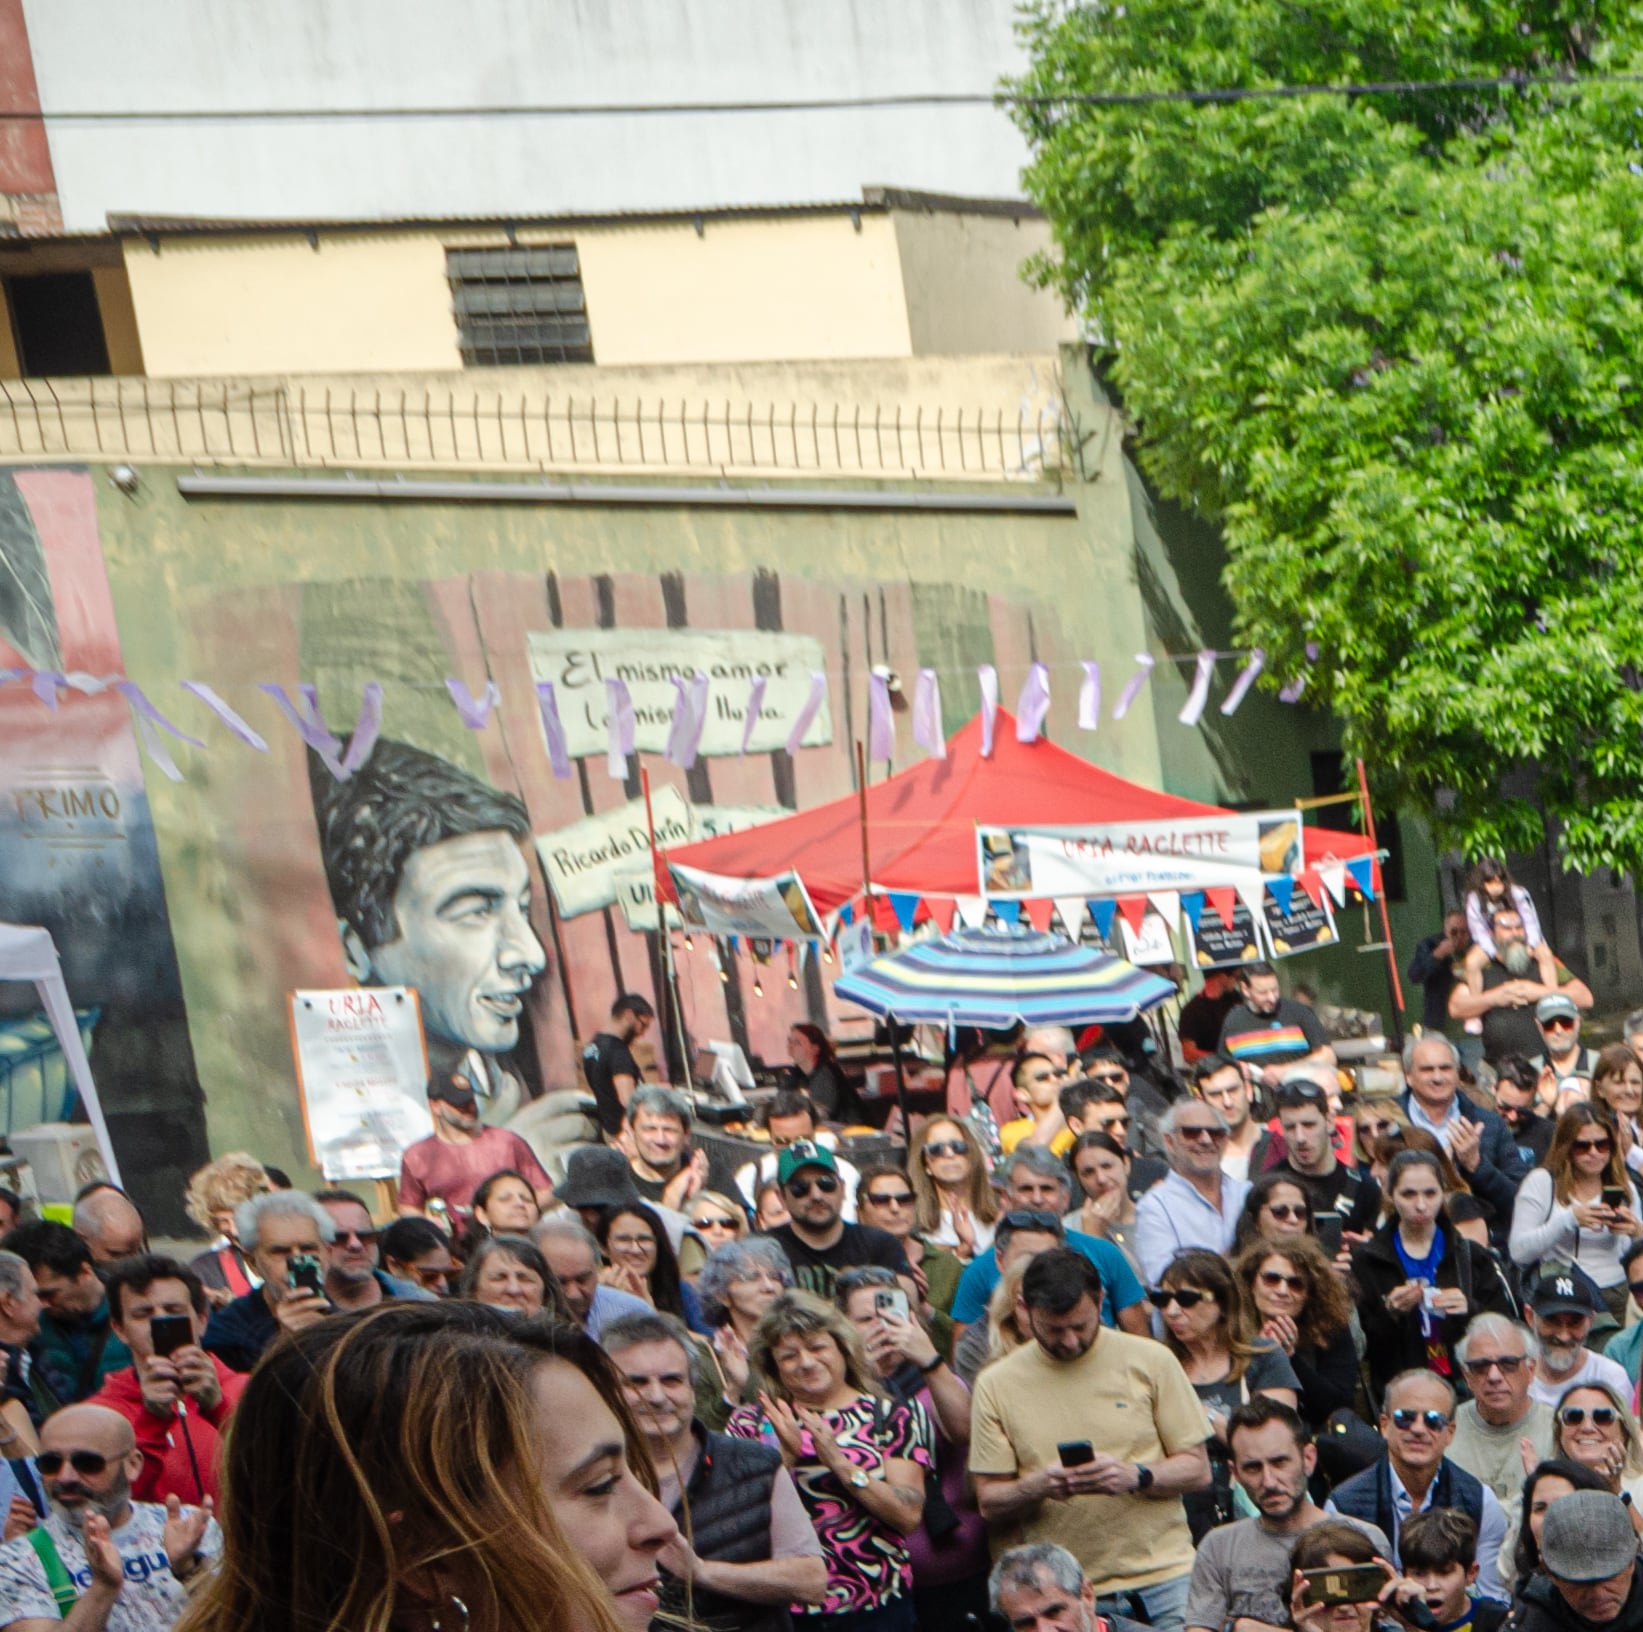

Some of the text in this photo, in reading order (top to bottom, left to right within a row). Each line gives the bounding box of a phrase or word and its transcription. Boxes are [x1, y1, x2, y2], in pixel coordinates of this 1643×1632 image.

[560, 650, 602, 689] El
[710, 660, 788, 680] amor
[551, 839, 632, 877] Ricardo
[1125, 829, 1232, 856] RACLETTE
